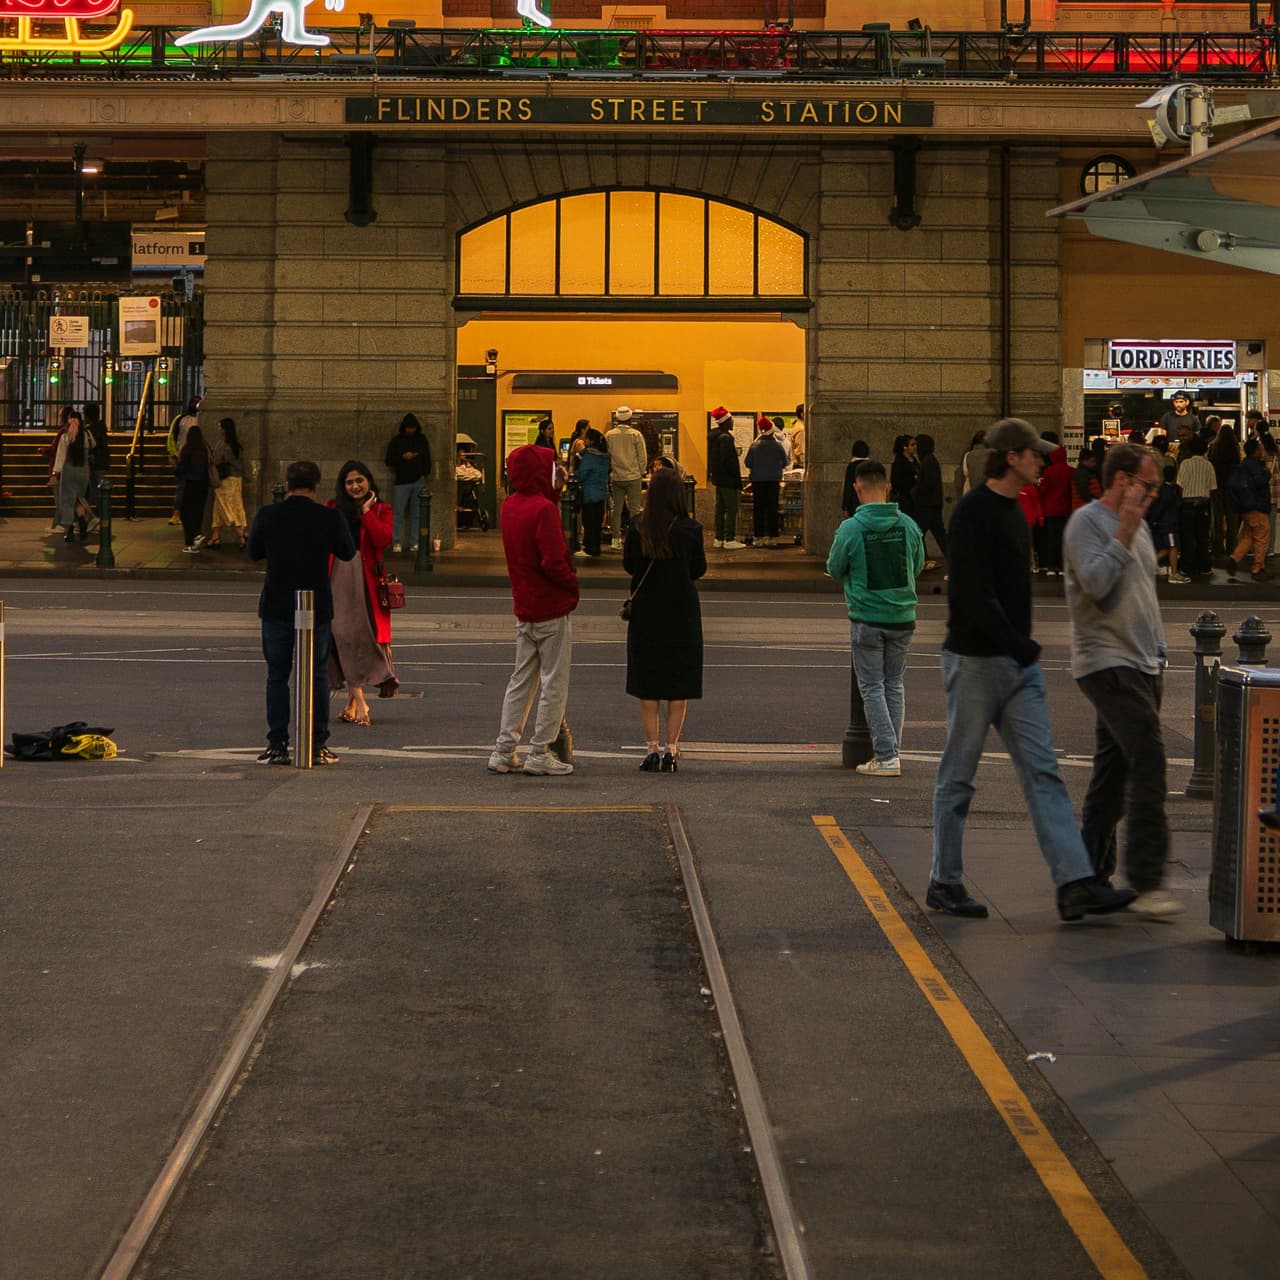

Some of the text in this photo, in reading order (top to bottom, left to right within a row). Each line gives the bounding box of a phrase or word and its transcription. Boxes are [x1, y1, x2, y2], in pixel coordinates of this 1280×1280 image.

[377, 98, 903, 124] FLINDERS STREET STATION
[132, 242, 200, 255] latform 1
[1111, 349, 1234, 370] LORD OF THE FRIES
[587, 377, 612, 385] Tickets
